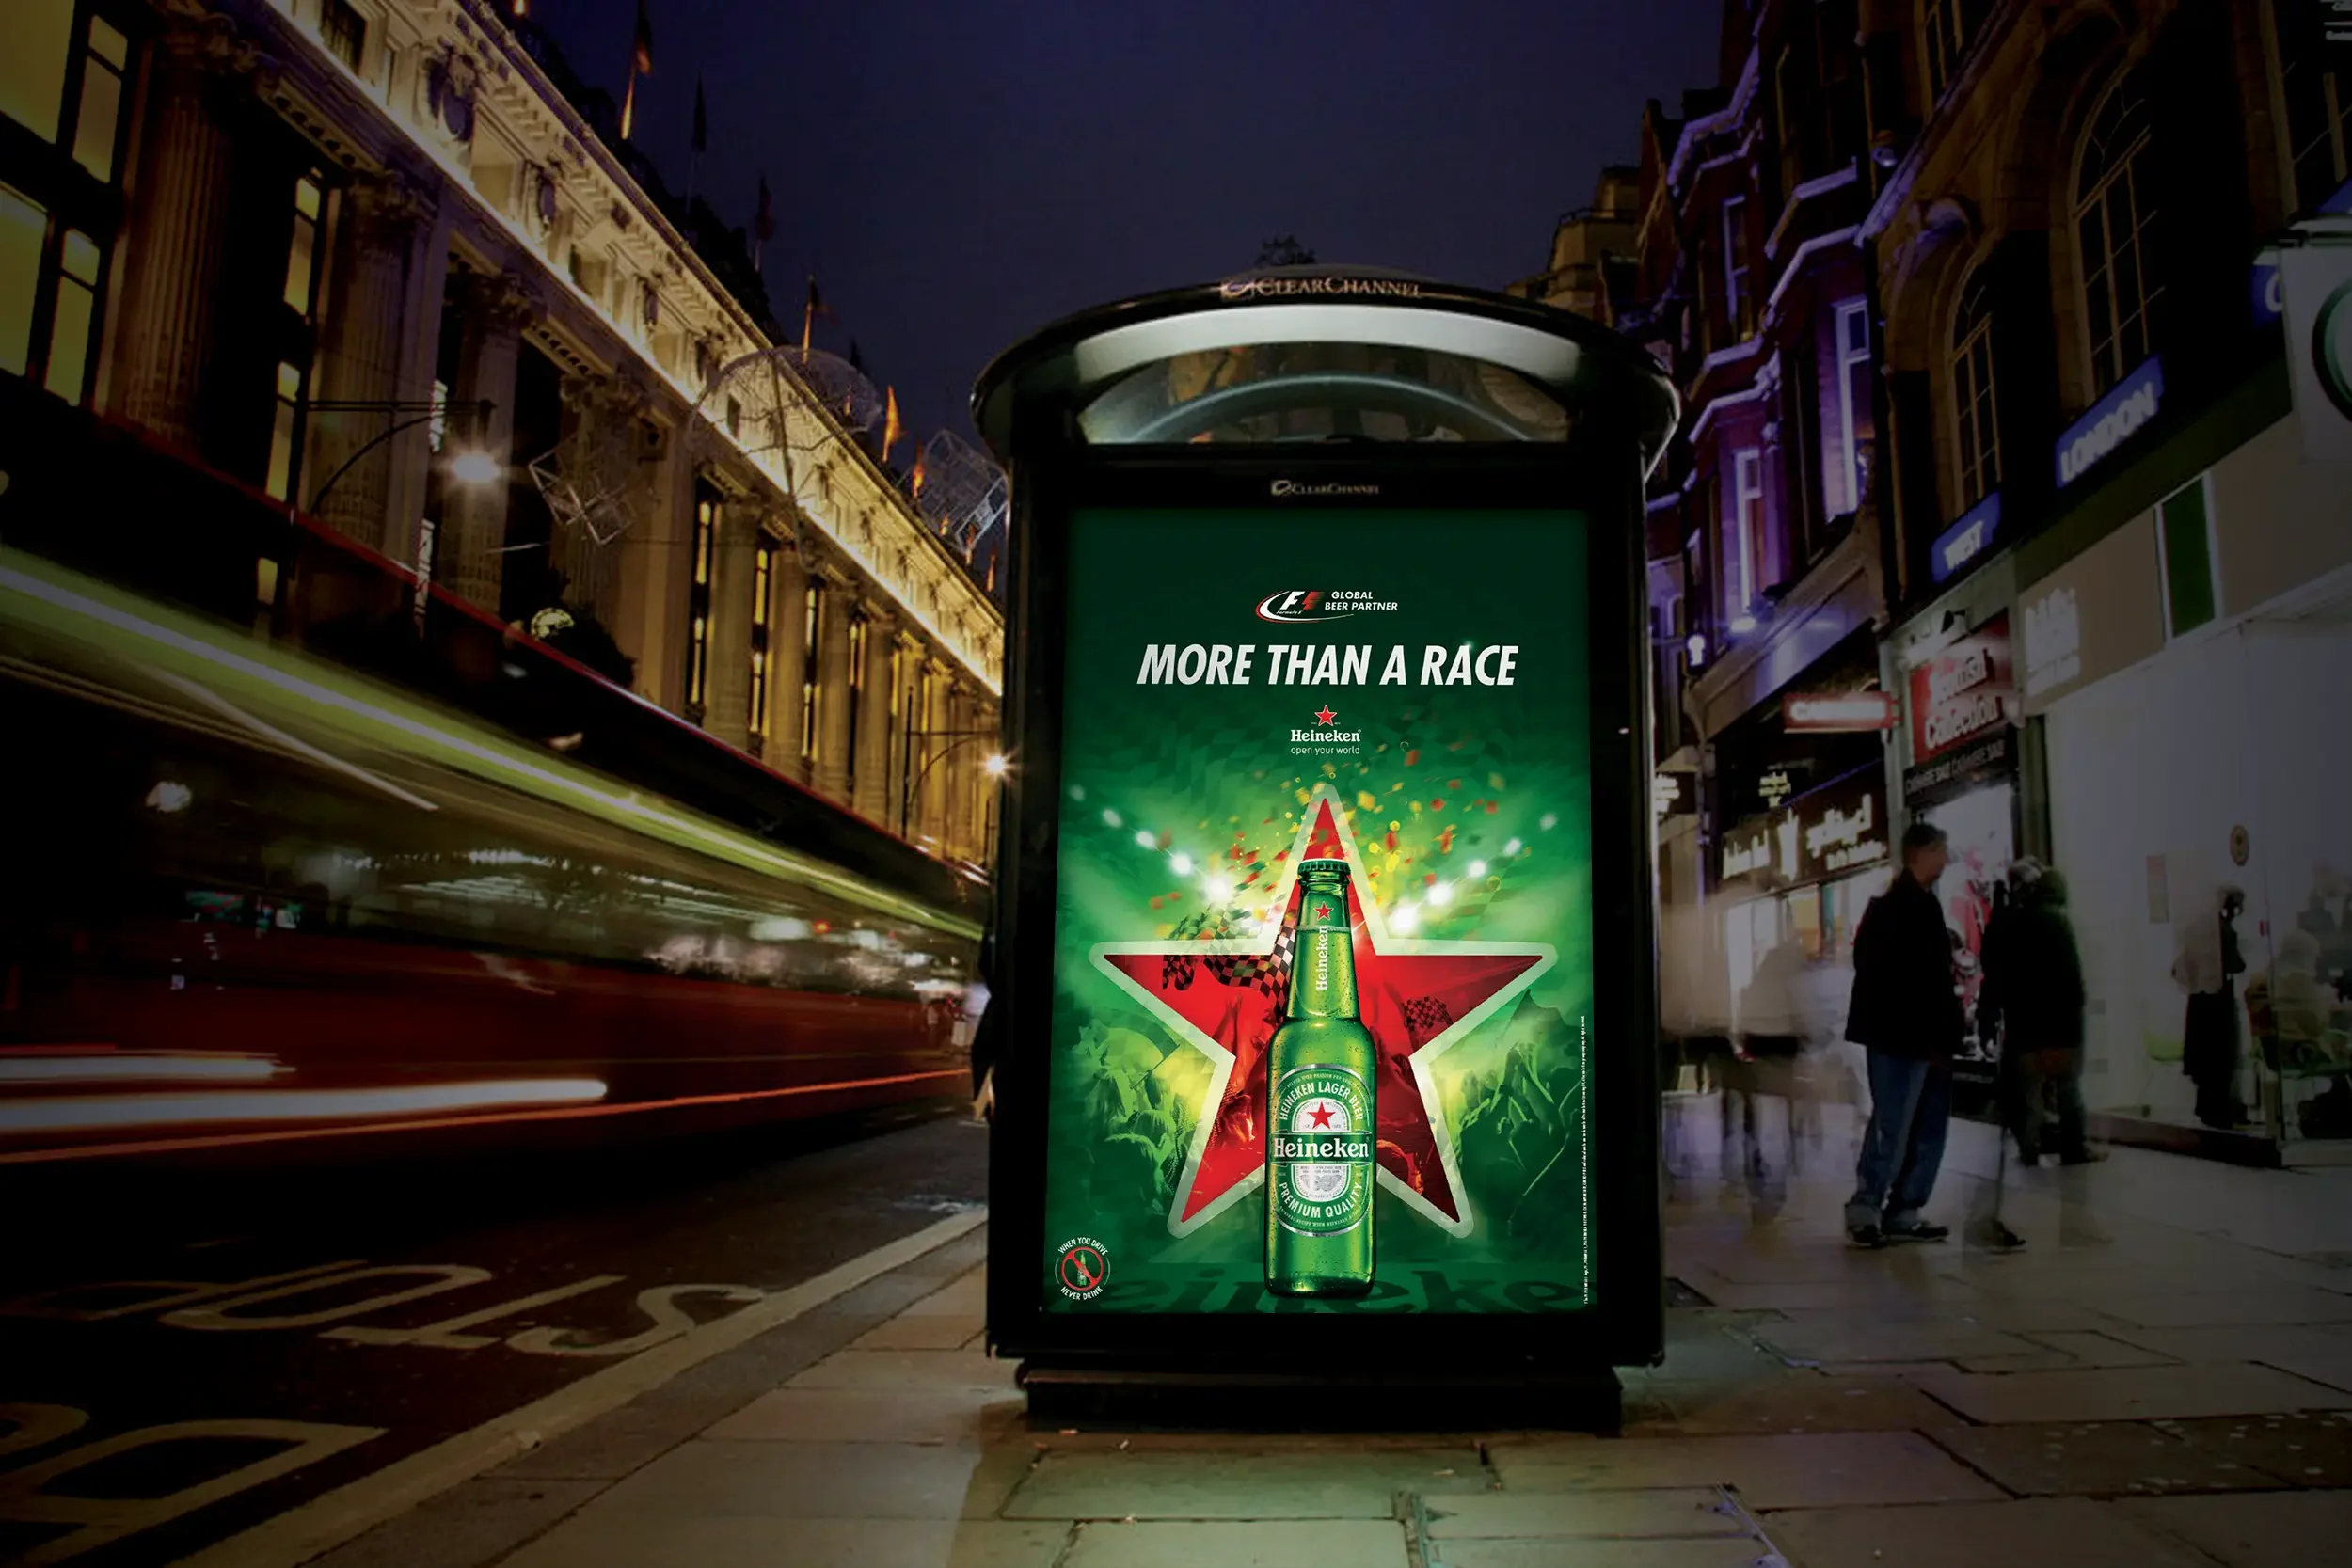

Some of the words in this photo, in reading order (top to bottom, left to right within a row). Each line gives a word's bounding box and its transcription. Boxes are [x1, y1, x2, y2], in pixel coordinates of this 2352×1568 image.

[2059, 382, 2157, 482] LONDON
[1325, 602, 1348, 610] BEER
[1351, 602, 1398, 610] PARTNER
[1331, 591, 1374, 600] GLOBAL
[1136, 643, 1256, 685] MORE
[1267, 644, 1374, 685] THAN
[1379, 645, 1407, 686] A
[1420, 644, 1519, 686] RACE
[1291, 747, 1312, 755] open
[1315, 747, 1334, 755] your
[1336, 745, 1360, 754] world
[1316, 925, 1328, 990] Heineken
[1279, 1082, 1315, 1120] HEINEKEN
[1318, 1082, 1350, 1099] LAGER
[1348, 1094, 1364, 1120] BEER
[1274, 1137, 1369, 1158] Heineken
[1279, 1181, 1321, 1218] PREMIUM
[1325, 1181, 1363, 1218] QUALITY
[1057, 1239, 1076, 1254] WHEN
[1091, 1240, 1108, 1256] DRIVE
[1060, 1286, 1081, 1300] NEVER
[1083, 1285, 1103, 1300] DRINK
